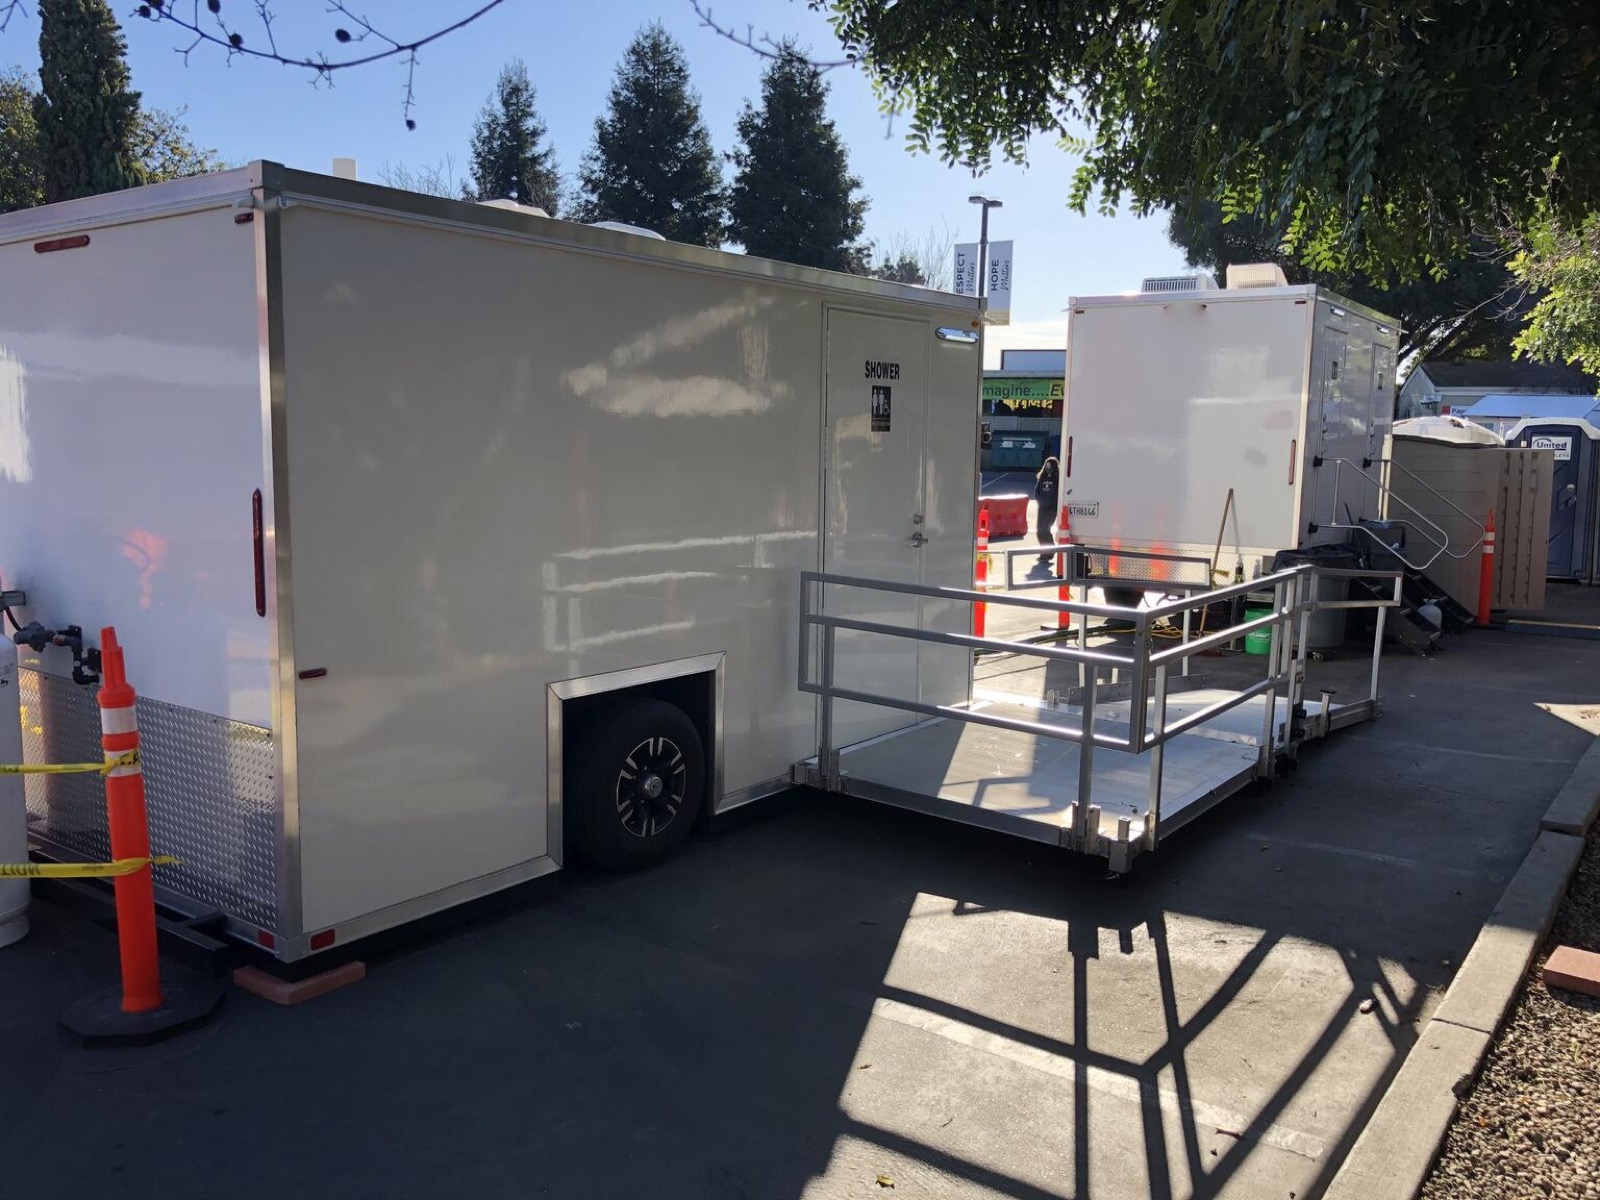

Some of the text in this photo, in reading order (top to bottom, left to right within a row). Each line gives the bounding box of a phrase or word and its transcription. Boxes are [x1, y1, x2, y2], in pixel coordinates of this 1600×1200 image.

[990, 259, 999, 292] HOPE
[865, 360, 900, 380] SHOWER
[1536, 441, 1567, 449] United
